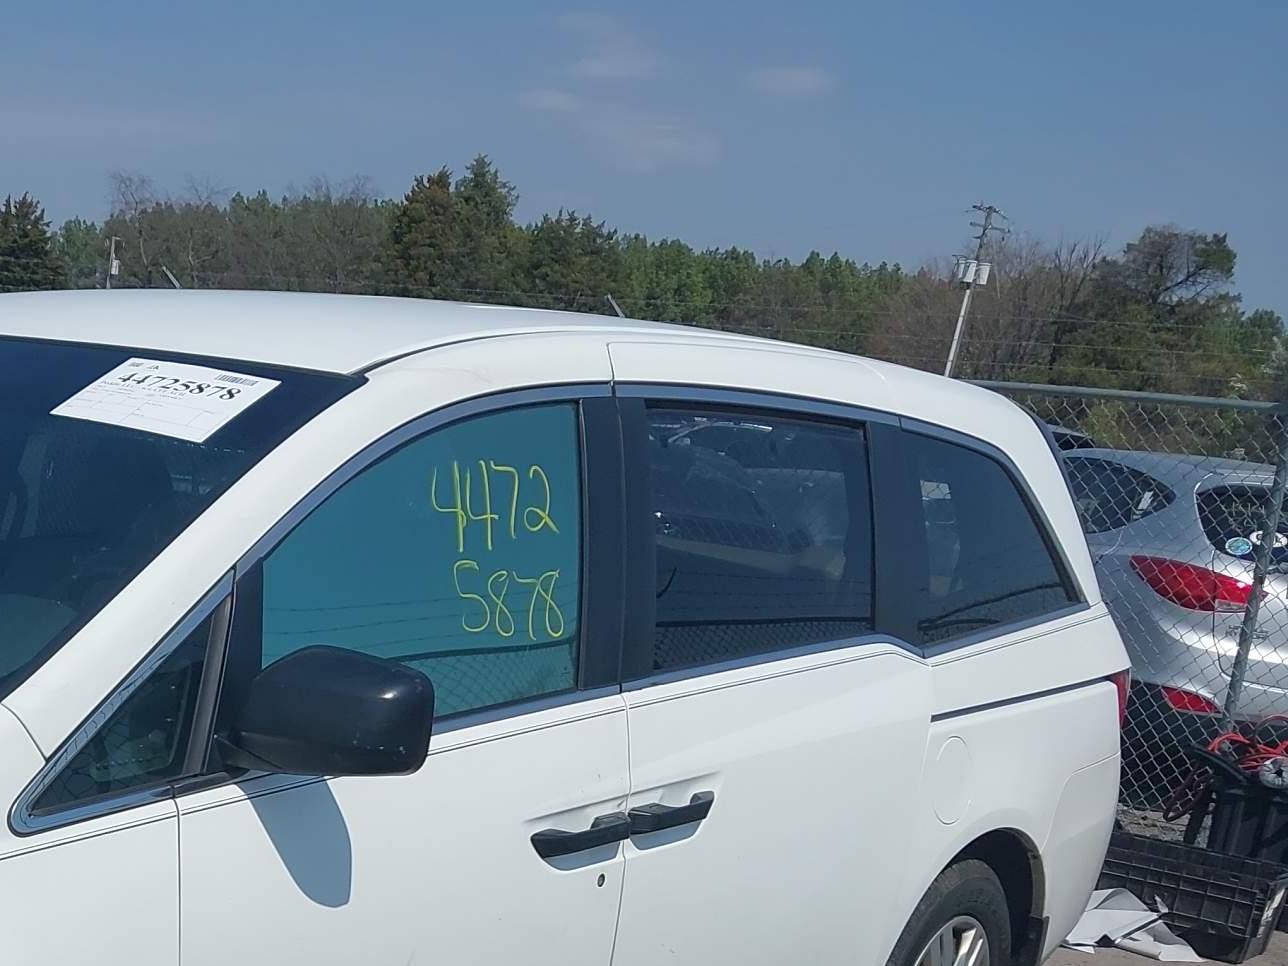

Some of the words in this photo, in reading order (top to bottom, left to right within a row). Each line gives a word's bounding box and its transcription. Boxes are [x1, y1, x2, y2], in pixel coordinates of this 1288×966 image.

[118, 372, 242, 401] 44725878
[431, 459, 560, 553] 4472
[453, 559, 564, 640] 5878
